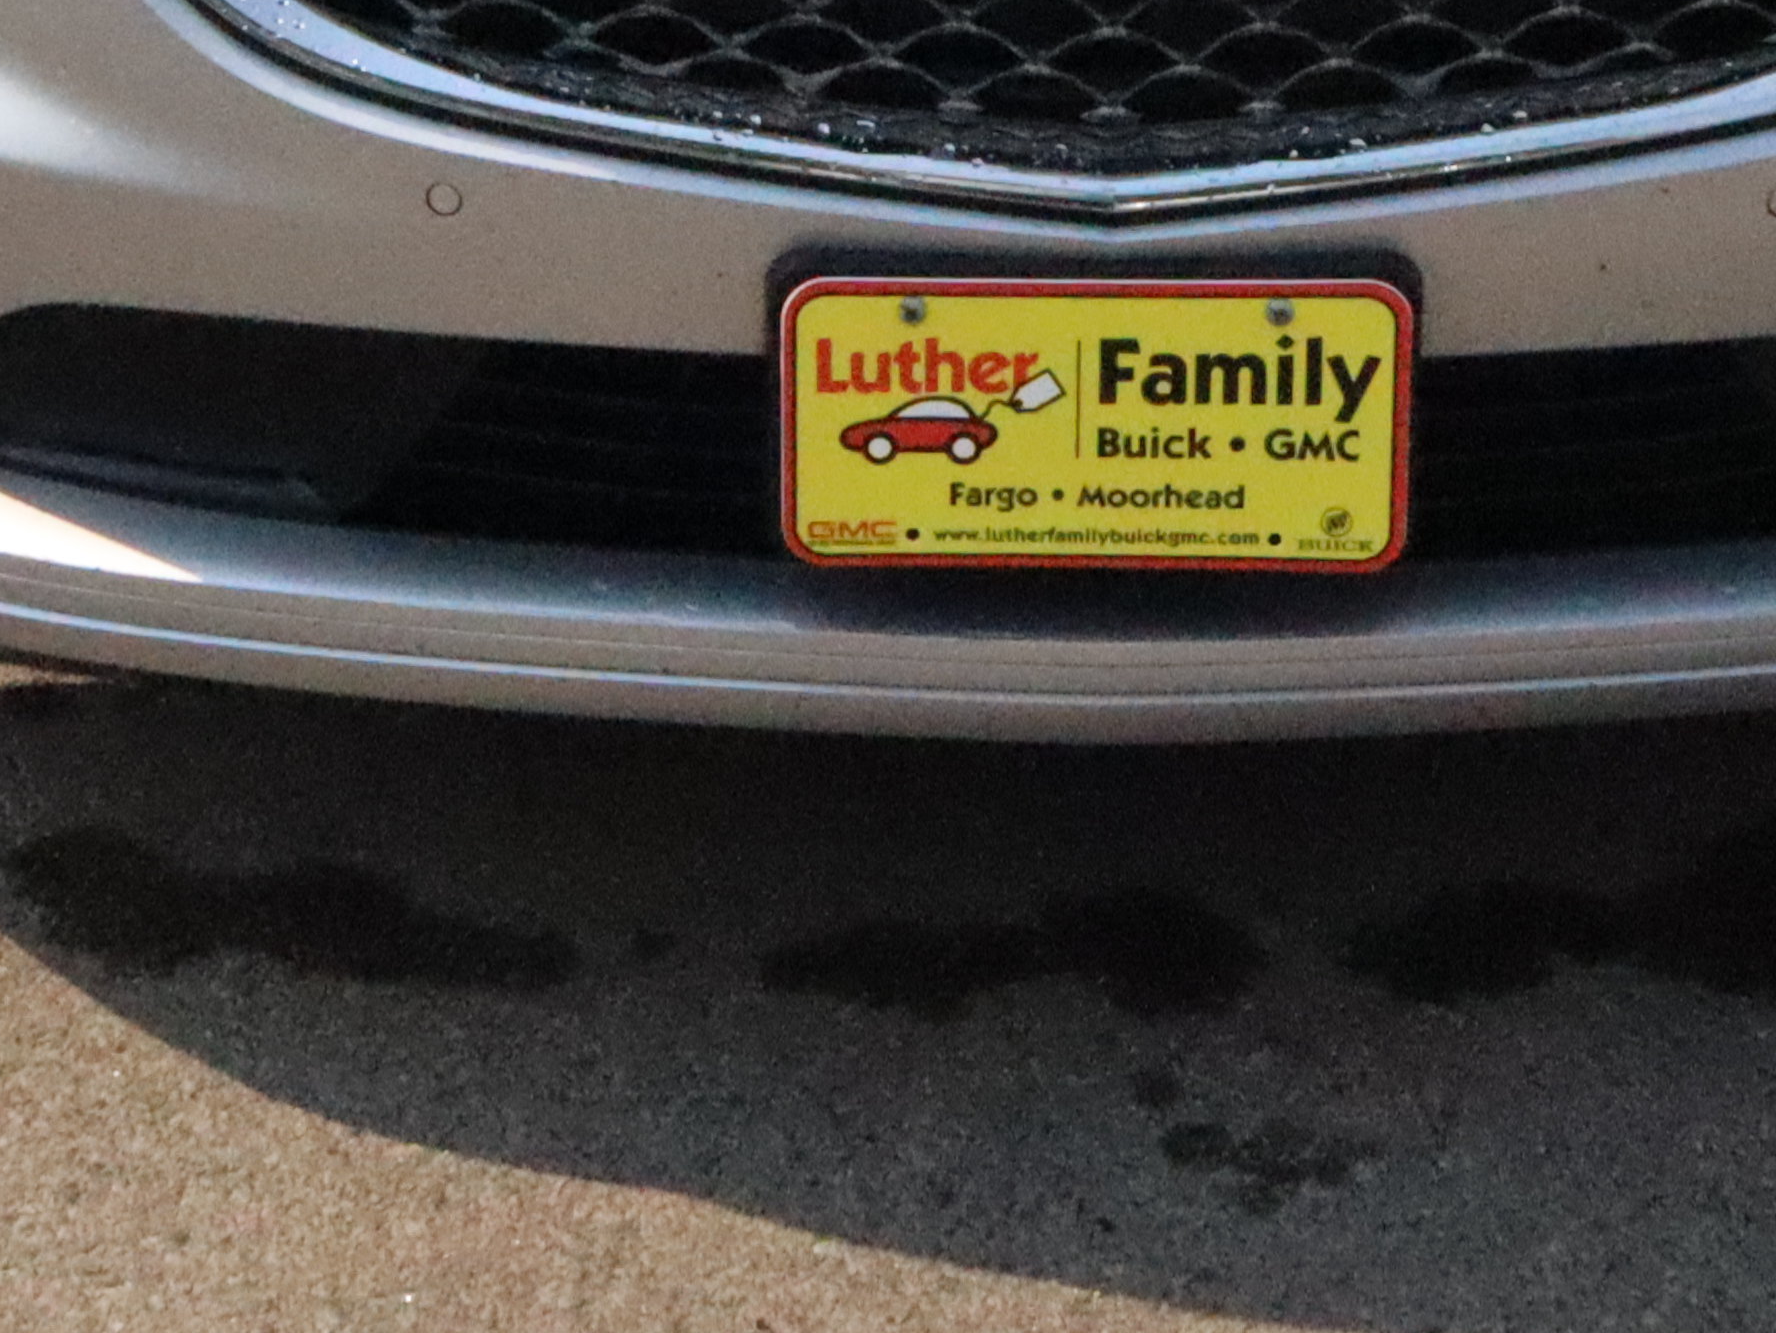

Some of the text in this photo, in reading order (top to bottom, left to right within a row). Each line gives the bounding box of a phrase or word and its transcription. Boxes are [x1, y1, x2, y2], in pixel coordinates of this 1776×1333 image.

[816, 334, 1382, 423] Luther Family
[1096, 427, 1361, 462] Buick GMC
[949, 482, 1245, 512] Fargo Moorhead
[807, 520, 897, 539] GMC
[932, 526, 1260, 548] www.lutherfamilybuickgmc.com
[1297, 538, 1375, 552] BUICK
